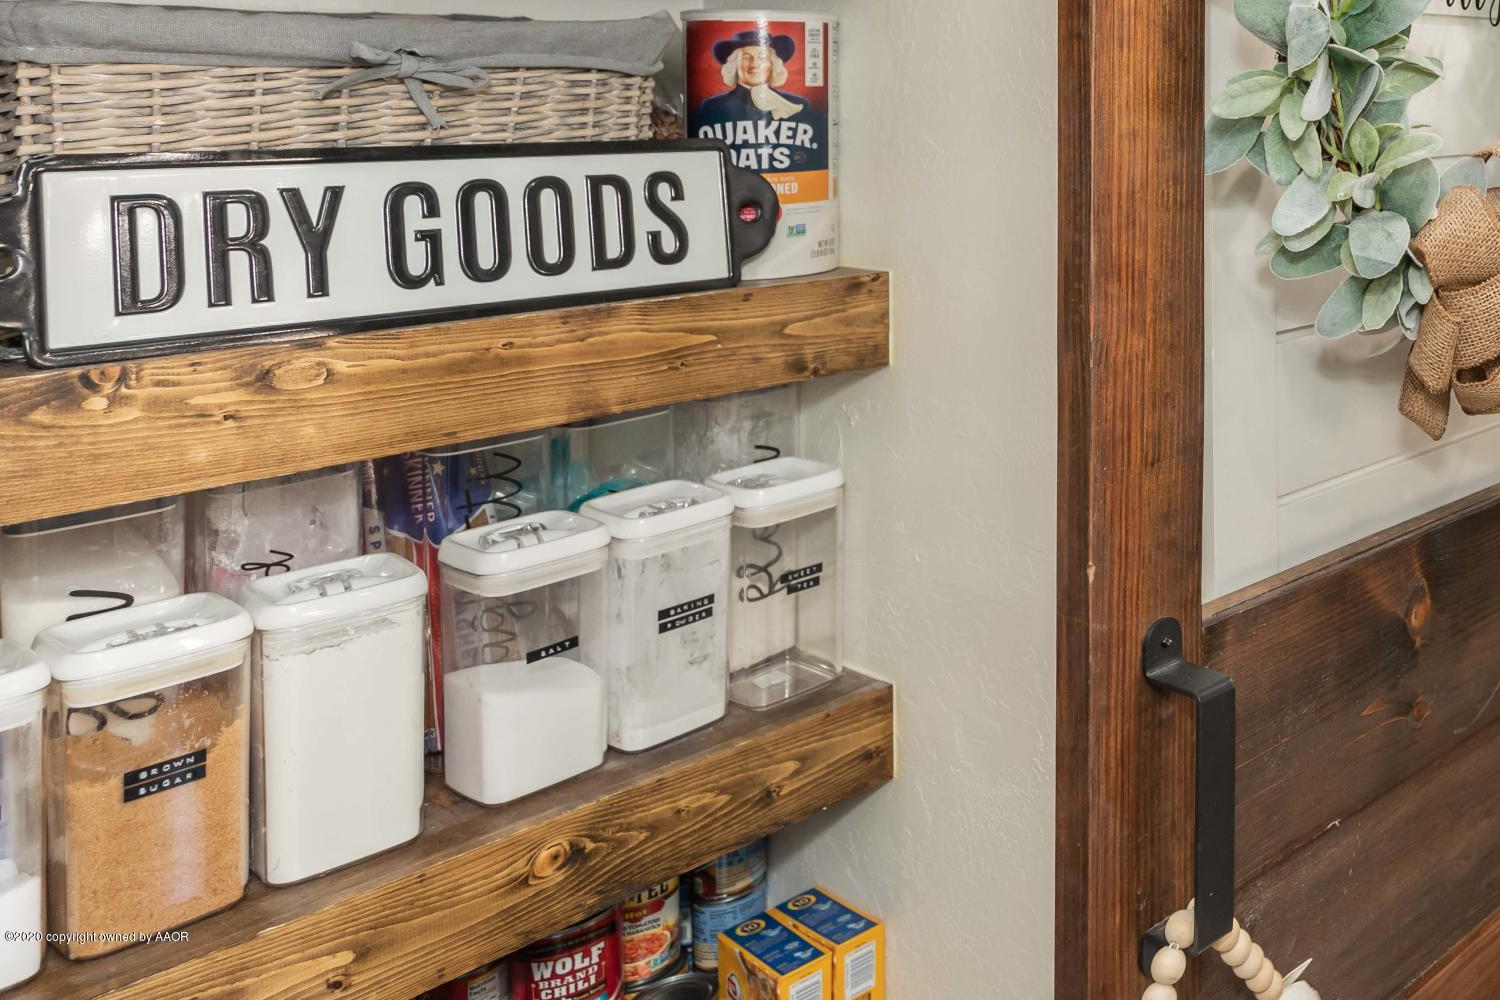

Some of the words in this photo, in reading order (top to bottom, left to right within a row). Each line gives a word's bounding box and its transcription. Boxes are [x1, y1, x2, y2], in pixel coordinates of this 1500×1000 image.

[109, 185, 345, 317] DRY
[383, 170, 690, 290] GOODS
[797, 580, 814, 590] TEA
[669, 598, 709, 616] BAKING
[541, 641, 570, 657] SALT
[139, 756, 195, 780] BROWN
[138, 772, 193, 796] SUGAR
[794, 897, 809, 907] 10
[743, 923, 758, 934] 10
[530, 941, 606, 982] WOLF
[537, 964, 600, 992] BRAND
[540, 976, 597, 1000] CHILI
